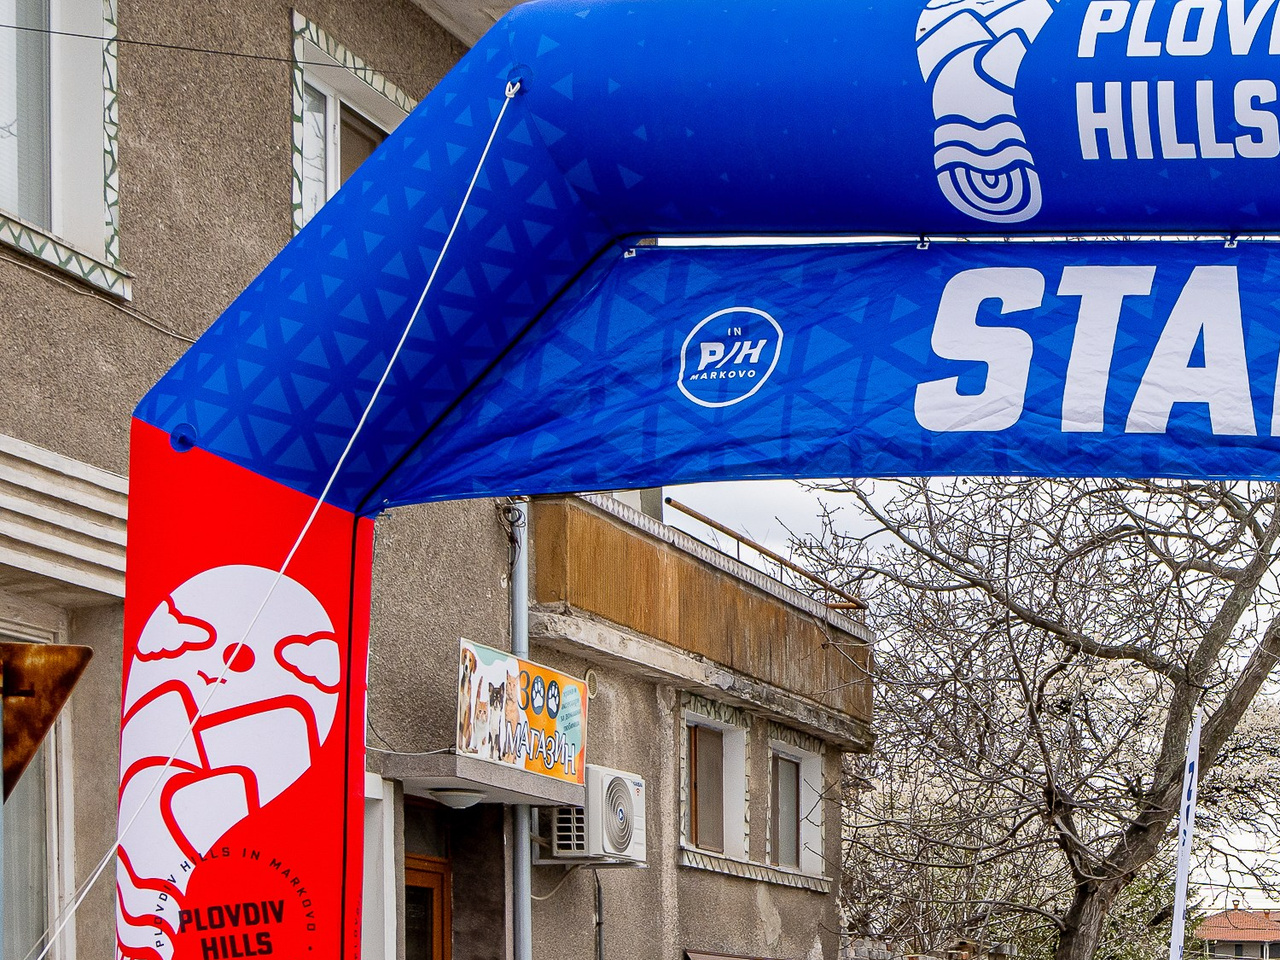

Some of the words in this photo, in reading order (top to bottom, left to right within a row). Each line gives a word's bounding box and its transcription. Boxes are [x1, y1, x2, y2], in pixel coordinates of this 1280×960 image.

[1076, 79, 1280, 159] HILLS
[728, 327, 742, 336] IN
[698, 339, 767, 371] P/H
[690, 370, 756, 380] MARKOVO
[505, 721, 576, 775] МАГАЗИН
[154, 874, 177, 948] PLOVDIV
[180, 847, 231, 873] HILLS
[242, 848, 261, 860] IN
[269, 858, 317, 932] MARKOVO
[178, 899, 285, 934] PLOVDIV
[201, 931, 274, 960] HILLS
